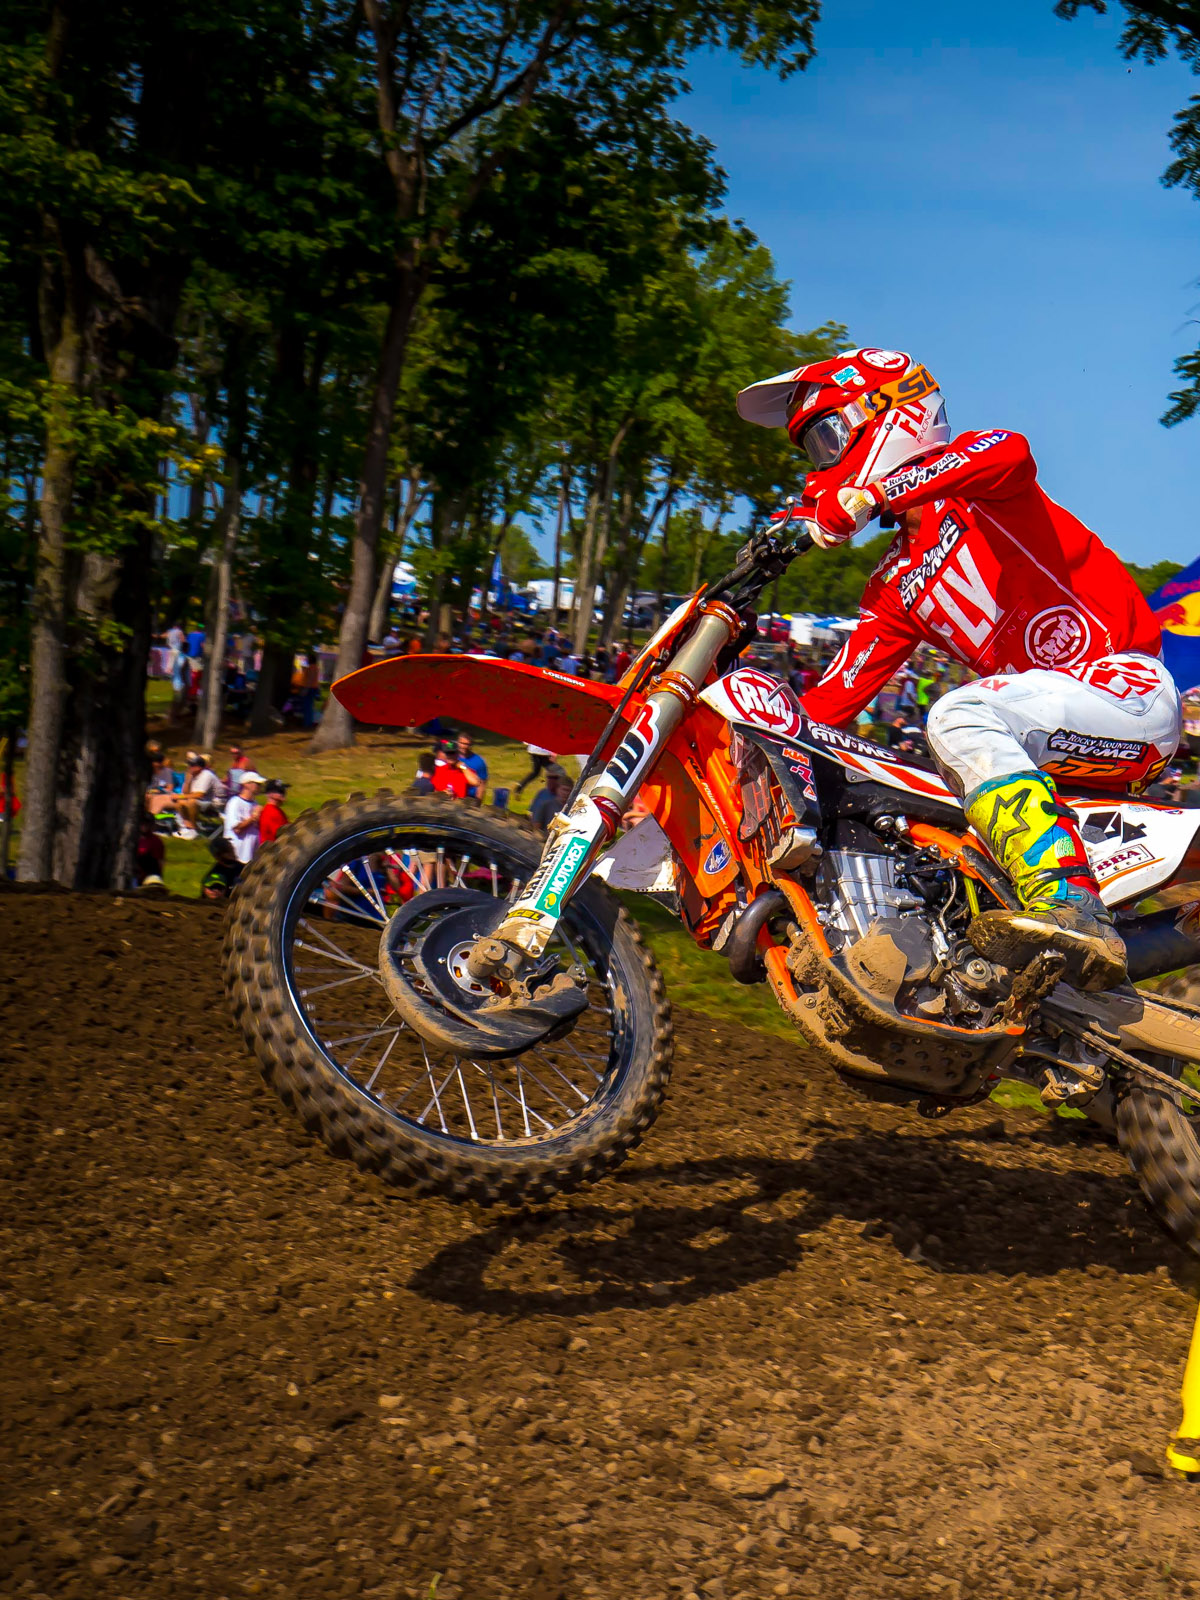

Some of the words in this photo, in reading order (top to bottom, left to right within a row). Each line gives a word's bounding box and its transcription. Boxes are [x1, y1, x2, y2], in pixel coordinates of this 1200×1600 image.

[917, 410, 933, 444] RACING
[1068, 734, 1097, 746] ROCKY
[1096, 739, 1142, 751] MOUNTAIN
[554, 841, 586, 895] MOTOREX
